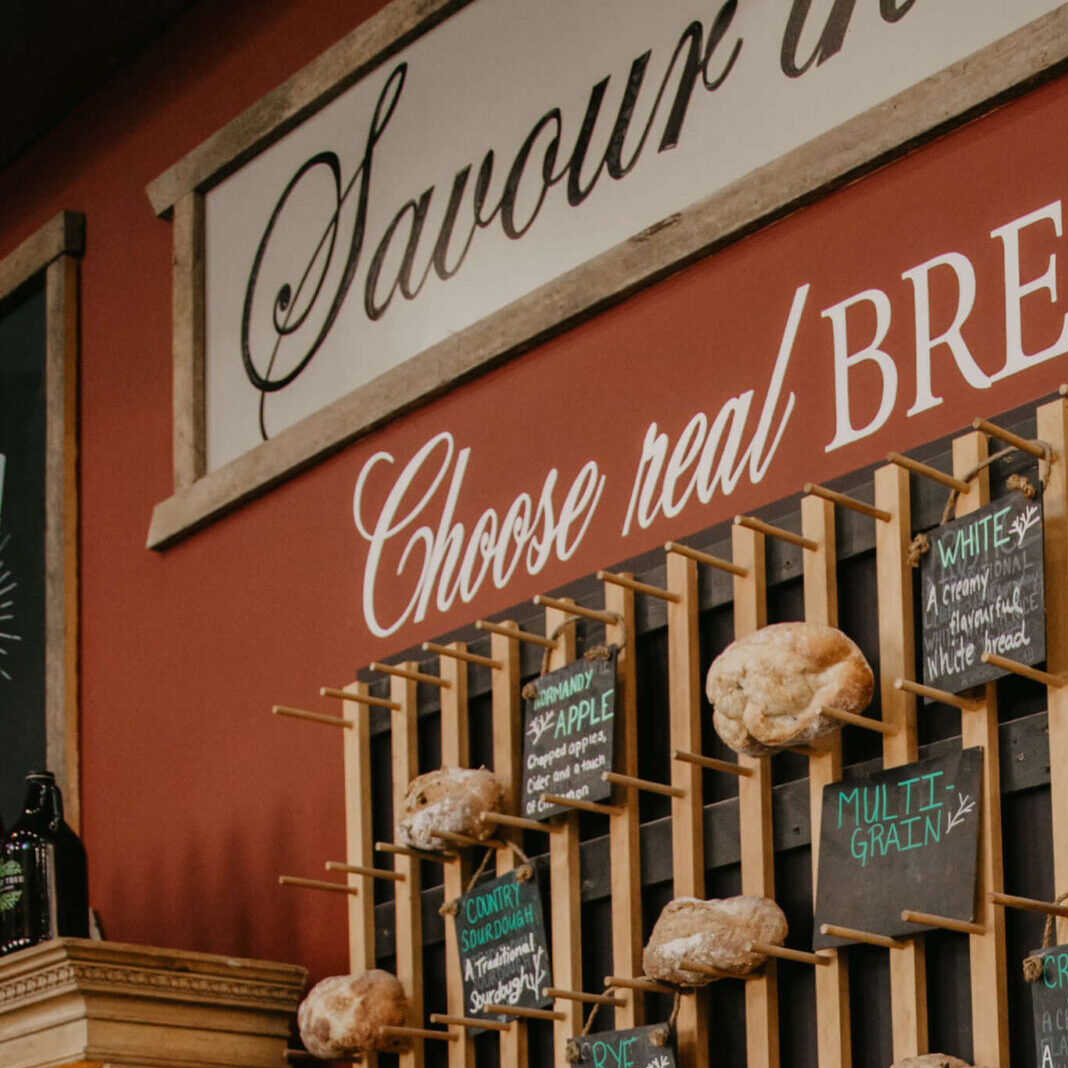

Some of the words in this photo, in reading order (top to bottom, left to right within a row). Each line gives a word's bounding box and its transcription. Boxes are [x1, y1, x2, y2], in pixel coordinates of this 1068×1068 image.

[241, 0, 743, 441] Savour
[353, 430, 606, 638] Choose
[622, 283, 810, 537] real
[937, 506, 1012, 569] WHITE
[926, 583, 938, 615] A
[942, 568, 990, 605] creamy
[949, 586, 1024, 637] flavourful
[533, 668, 594, 711] NORMANDY
[553, 688, 615, 739] APPLE
[552, 765, 570, 782] and
[574, 762, 580, 774] a
[838, 771, 955, 829] MULTI-
[850, 810, 942, 868] GRAIN
[461, 903, 534, 952] SOURDOUGH
[466, 882, 521, 925] COUNTRY
[464, 957, 475, 982] A
[474, 932, 535, 978] Traditional
